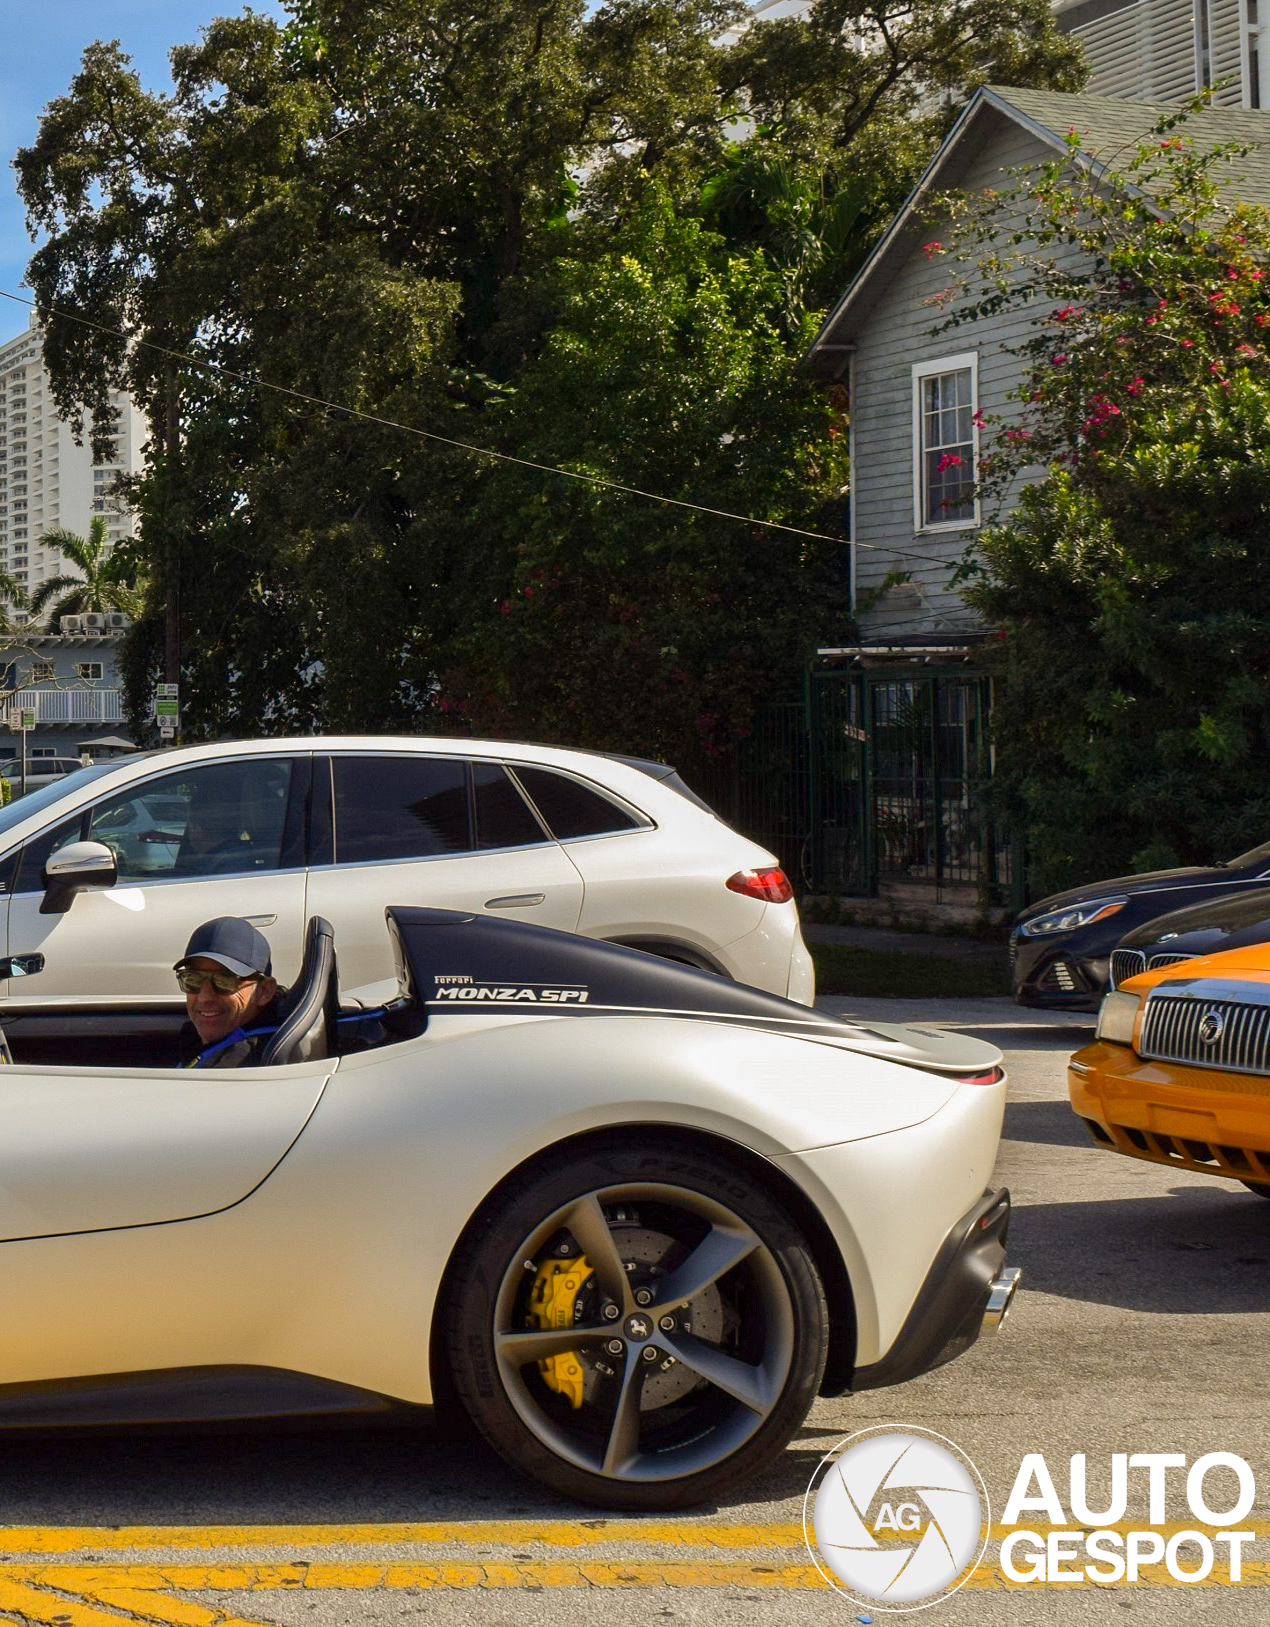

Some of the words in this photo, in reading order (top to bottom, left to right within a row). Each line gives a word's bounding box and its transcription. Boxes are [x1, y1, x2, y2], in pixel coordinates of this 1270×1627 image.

[434, 976, 474, 984] Ferrari
[436, 988, 537, 1000] MONZA
[539, 990, 589, 1002] SP1
